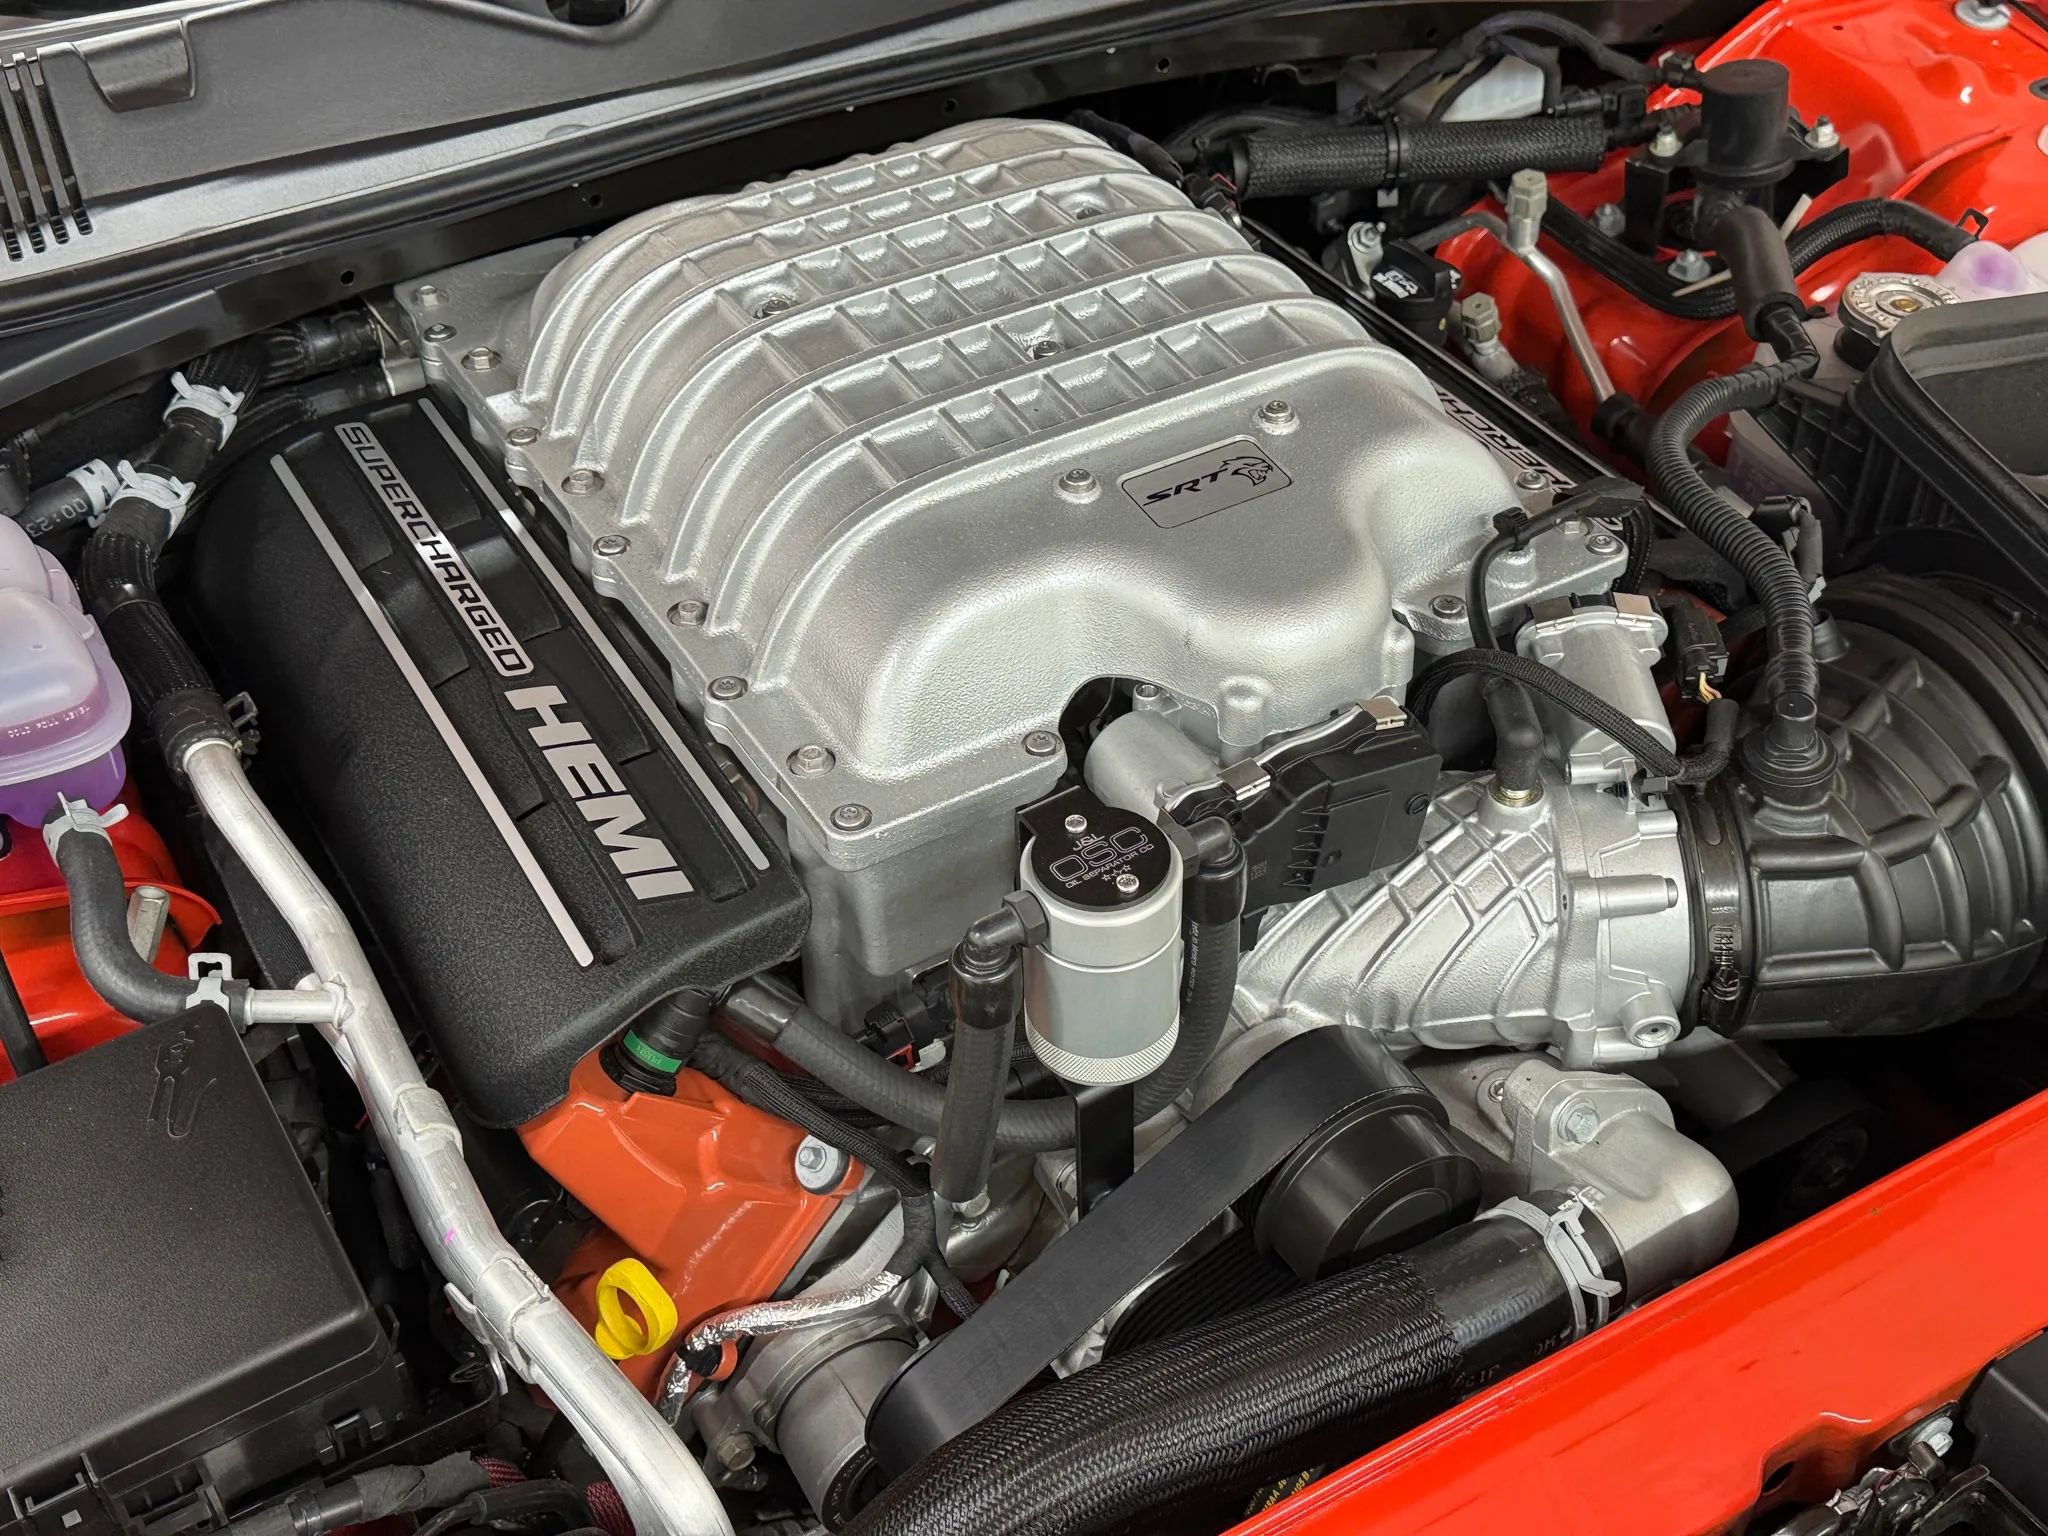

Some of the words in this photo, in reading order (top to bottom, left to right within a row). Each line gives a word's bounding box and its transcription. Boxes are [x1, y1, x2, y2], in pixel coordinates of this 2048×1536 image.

[1143, 468, 1228, 506] SRT
[341, 426, 526, 673] SUPERCHARGED
[504, 685, 694, 900] HEMI
[1050, 827, 1148, 881] OSC
[1073, 833, 1105, 851] J&L
[1065, 879, 1082, 889] OIL
[1082, 851, 1139, 881] SEPARATOR
